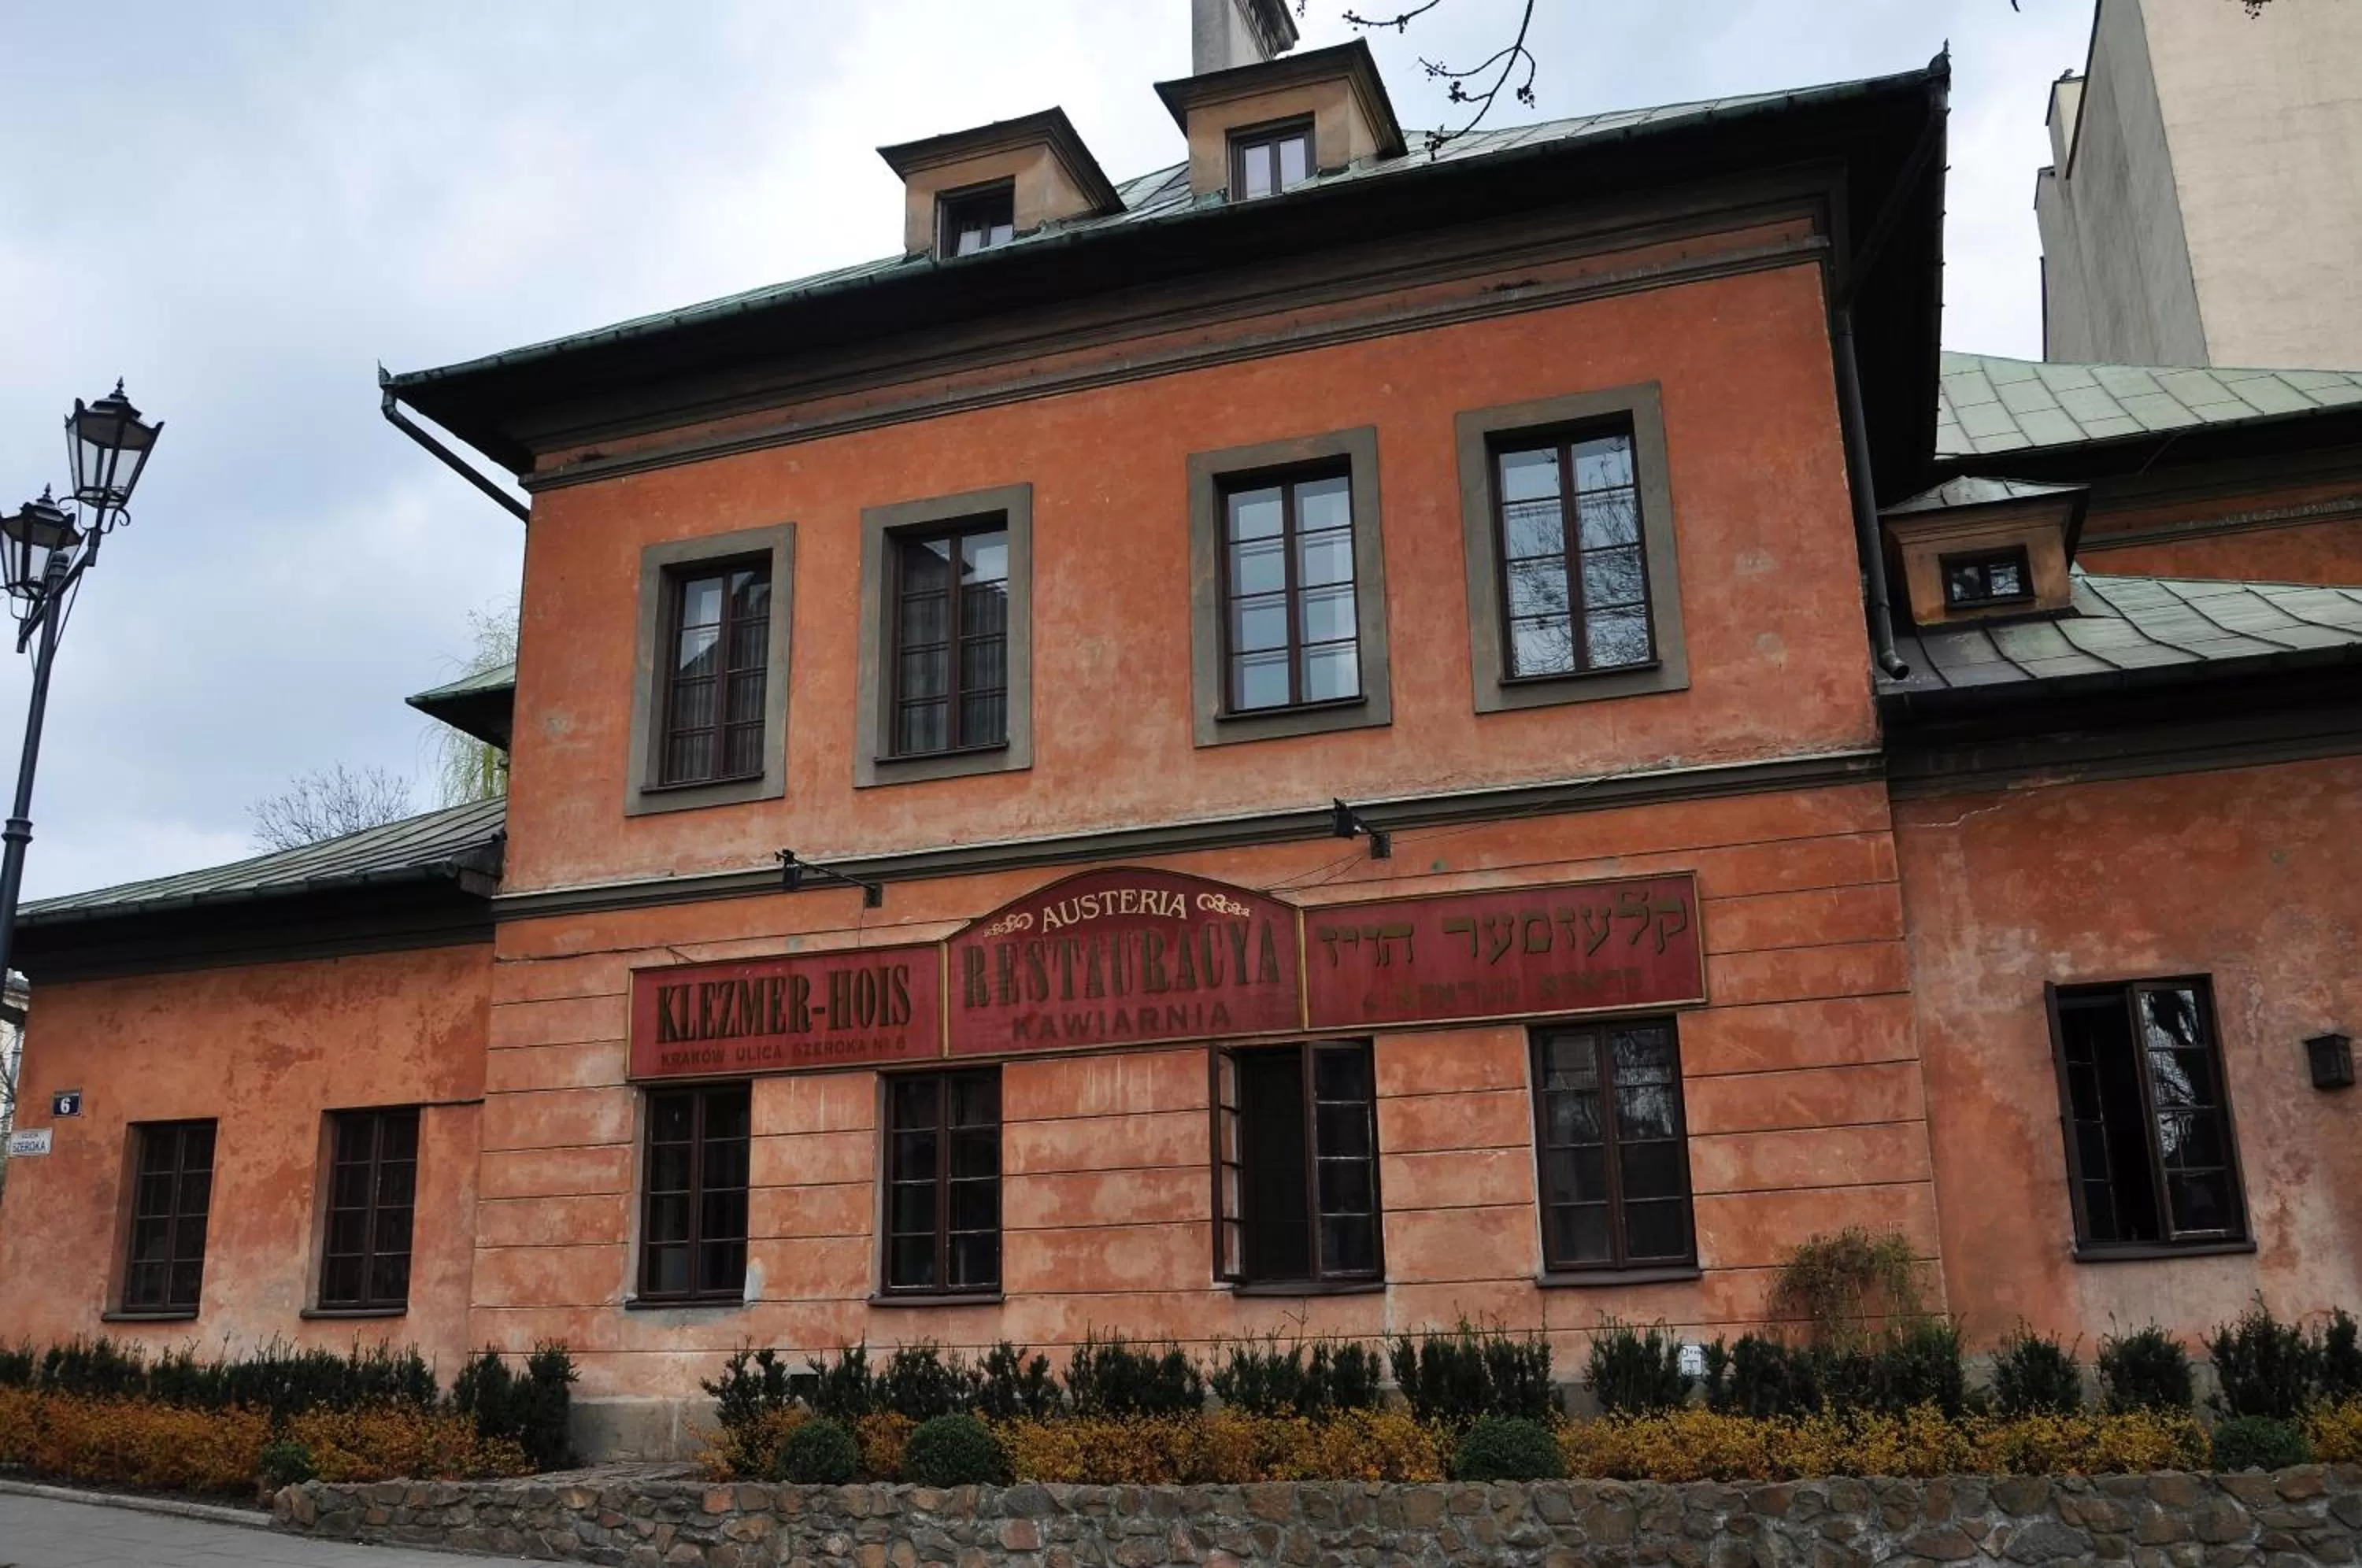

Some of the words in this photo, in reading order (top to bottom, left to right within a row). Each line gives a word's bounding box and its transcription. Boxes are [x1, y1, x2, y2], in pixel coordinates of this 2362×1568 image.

[1040, 889, 1187, 934] AUSTERIA
[962, 918, 1280, 1008] RESTAURACYA
[655, 964, 912, 1043] KLEZMER-HOIS
[1011, 1000, 1232, 1041] KAWIARNIA
[735, 1045, 782, 1061] ULICA
[60, 1096, 71, 1114] 6
